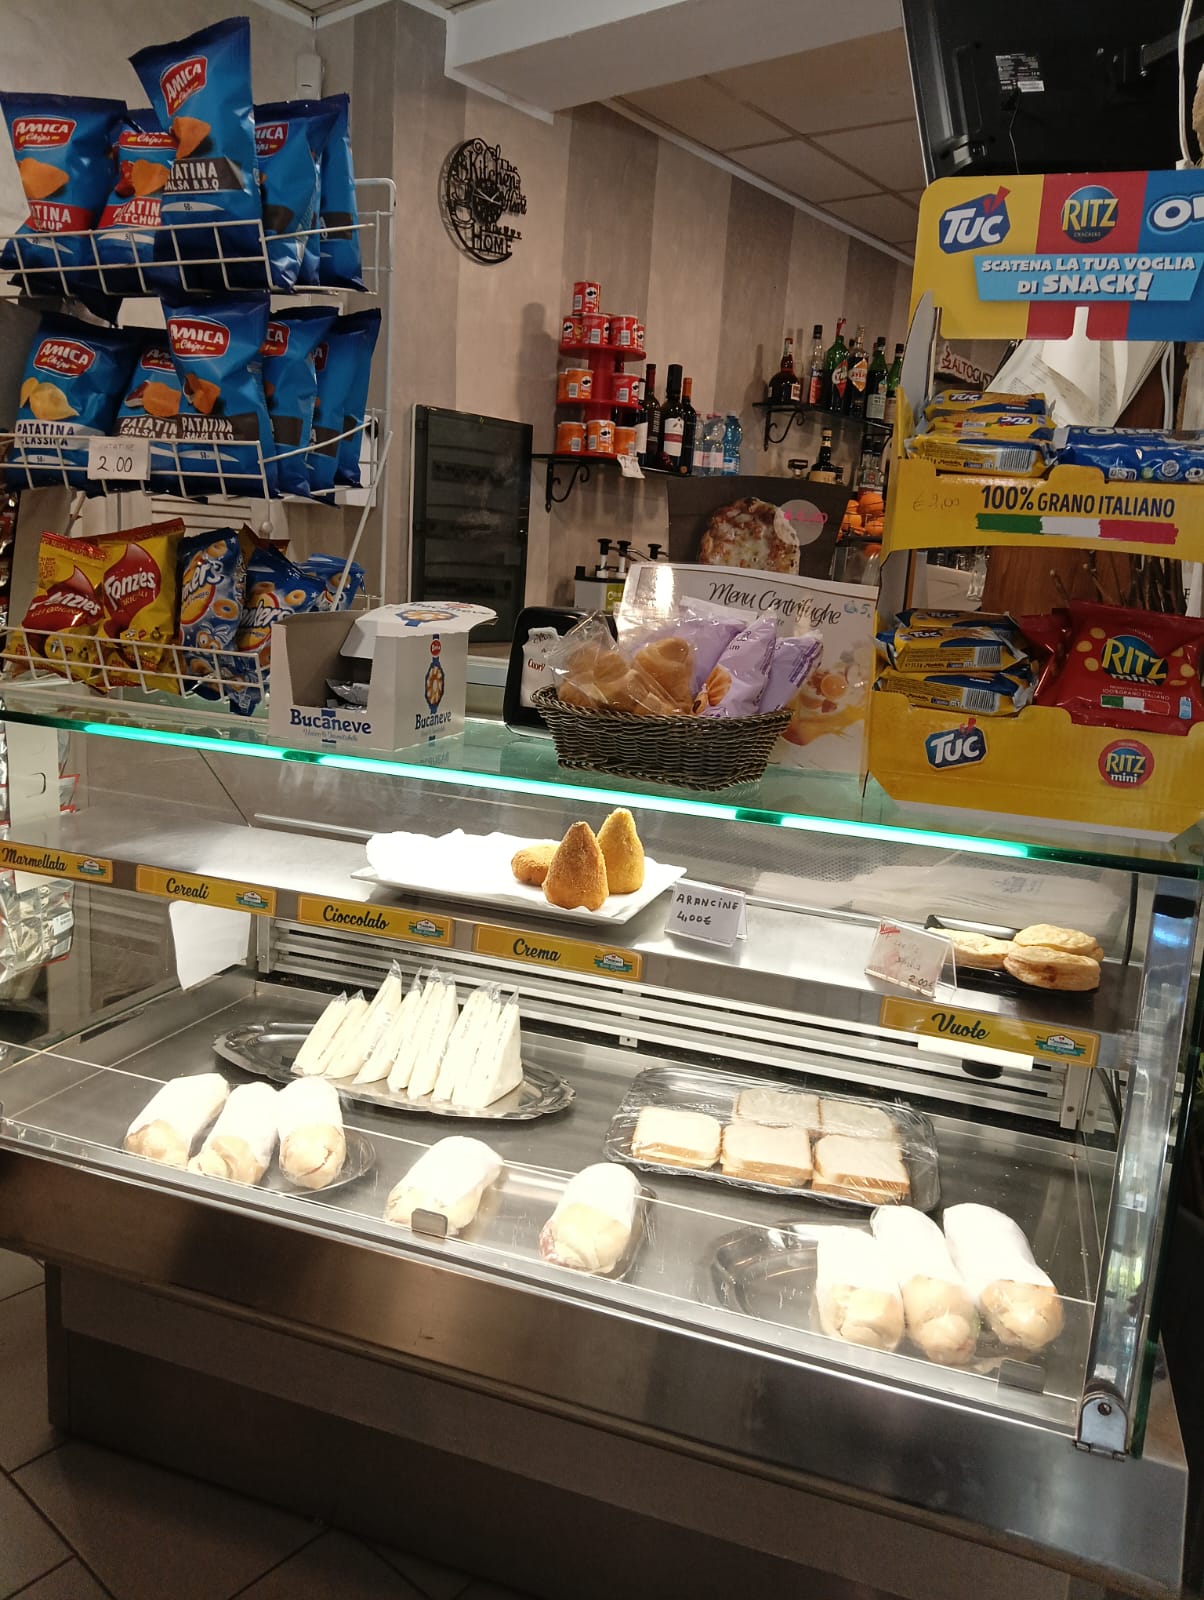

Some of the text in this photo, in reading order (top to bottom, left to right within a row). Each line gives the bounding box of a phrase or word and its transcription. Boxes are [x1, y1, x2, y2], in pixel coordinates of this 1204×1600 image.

[166, 62, 203, 104] AMICA
[15, 121, 70, 136] AMICA
[137, 134, 163, 145] Chips
[943, 206, 1005, 245] TUC
[1061, 198, 1120, 232] RITZ
[981, 255, 1196, 273] SCATENA LA TUA VOGLIA
[1017, 271, 1155, 301] DI SNACK!
[171, 323, 225, 345] AMICA
[39, 342, 90, 366] AMICA
[16, 421, 75, 436] PATATINA
[181, 418, 234, 434] PATATINA
[980, 485, 1176, 519] 100% GRANO ITALIANO
[103, 569, 157, 612] Fonzies
[708, 582, 757, 609] Menu
[1101, 637, 1168, 681] RITZ
[289, 708, 372, 735] Bucaneve
[414, 710, 453, 731] Bucaneve
[930, 734, 980, 765] TUC
[1105, 752, 1147, 775] RITZ
[1110, 772, 1138, 784] mini
[2, 846, 68, 873] Marmellata
[165, 877, 210, 900] Cereali
[676, 892, 740, 911] ARANCINE
[322, 904, 390, 931] Cioccolato
[512, 938, 562, 963] Crema
[931, 1012, 992, 1041] Vuote
